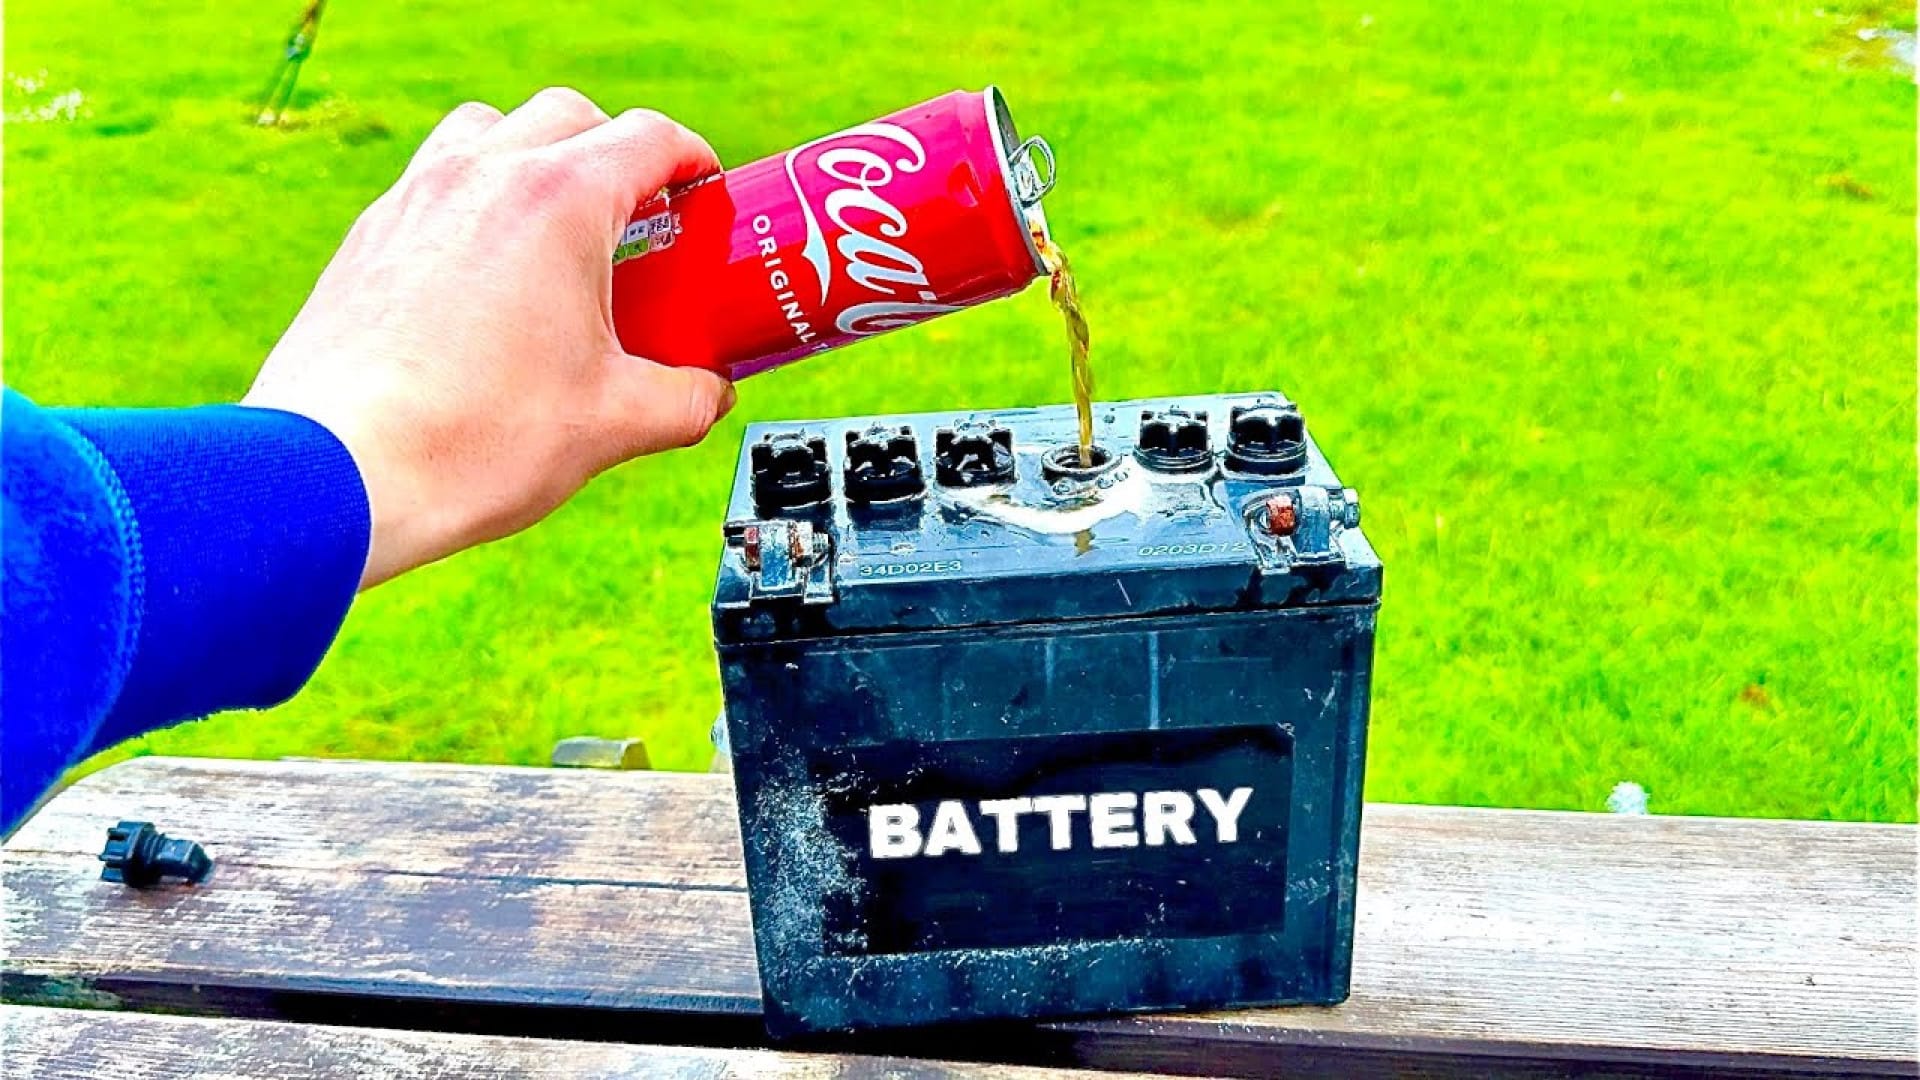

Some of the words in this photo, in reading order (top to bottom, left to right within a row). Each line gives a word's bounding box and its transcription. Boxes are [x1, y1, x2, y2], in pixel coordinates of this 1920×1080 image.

[752, 214, 817, 343] ORIGINAL
[860, 560, 961, 577] 34D02E3
[868, 788, 1254, 859] BATTERY
